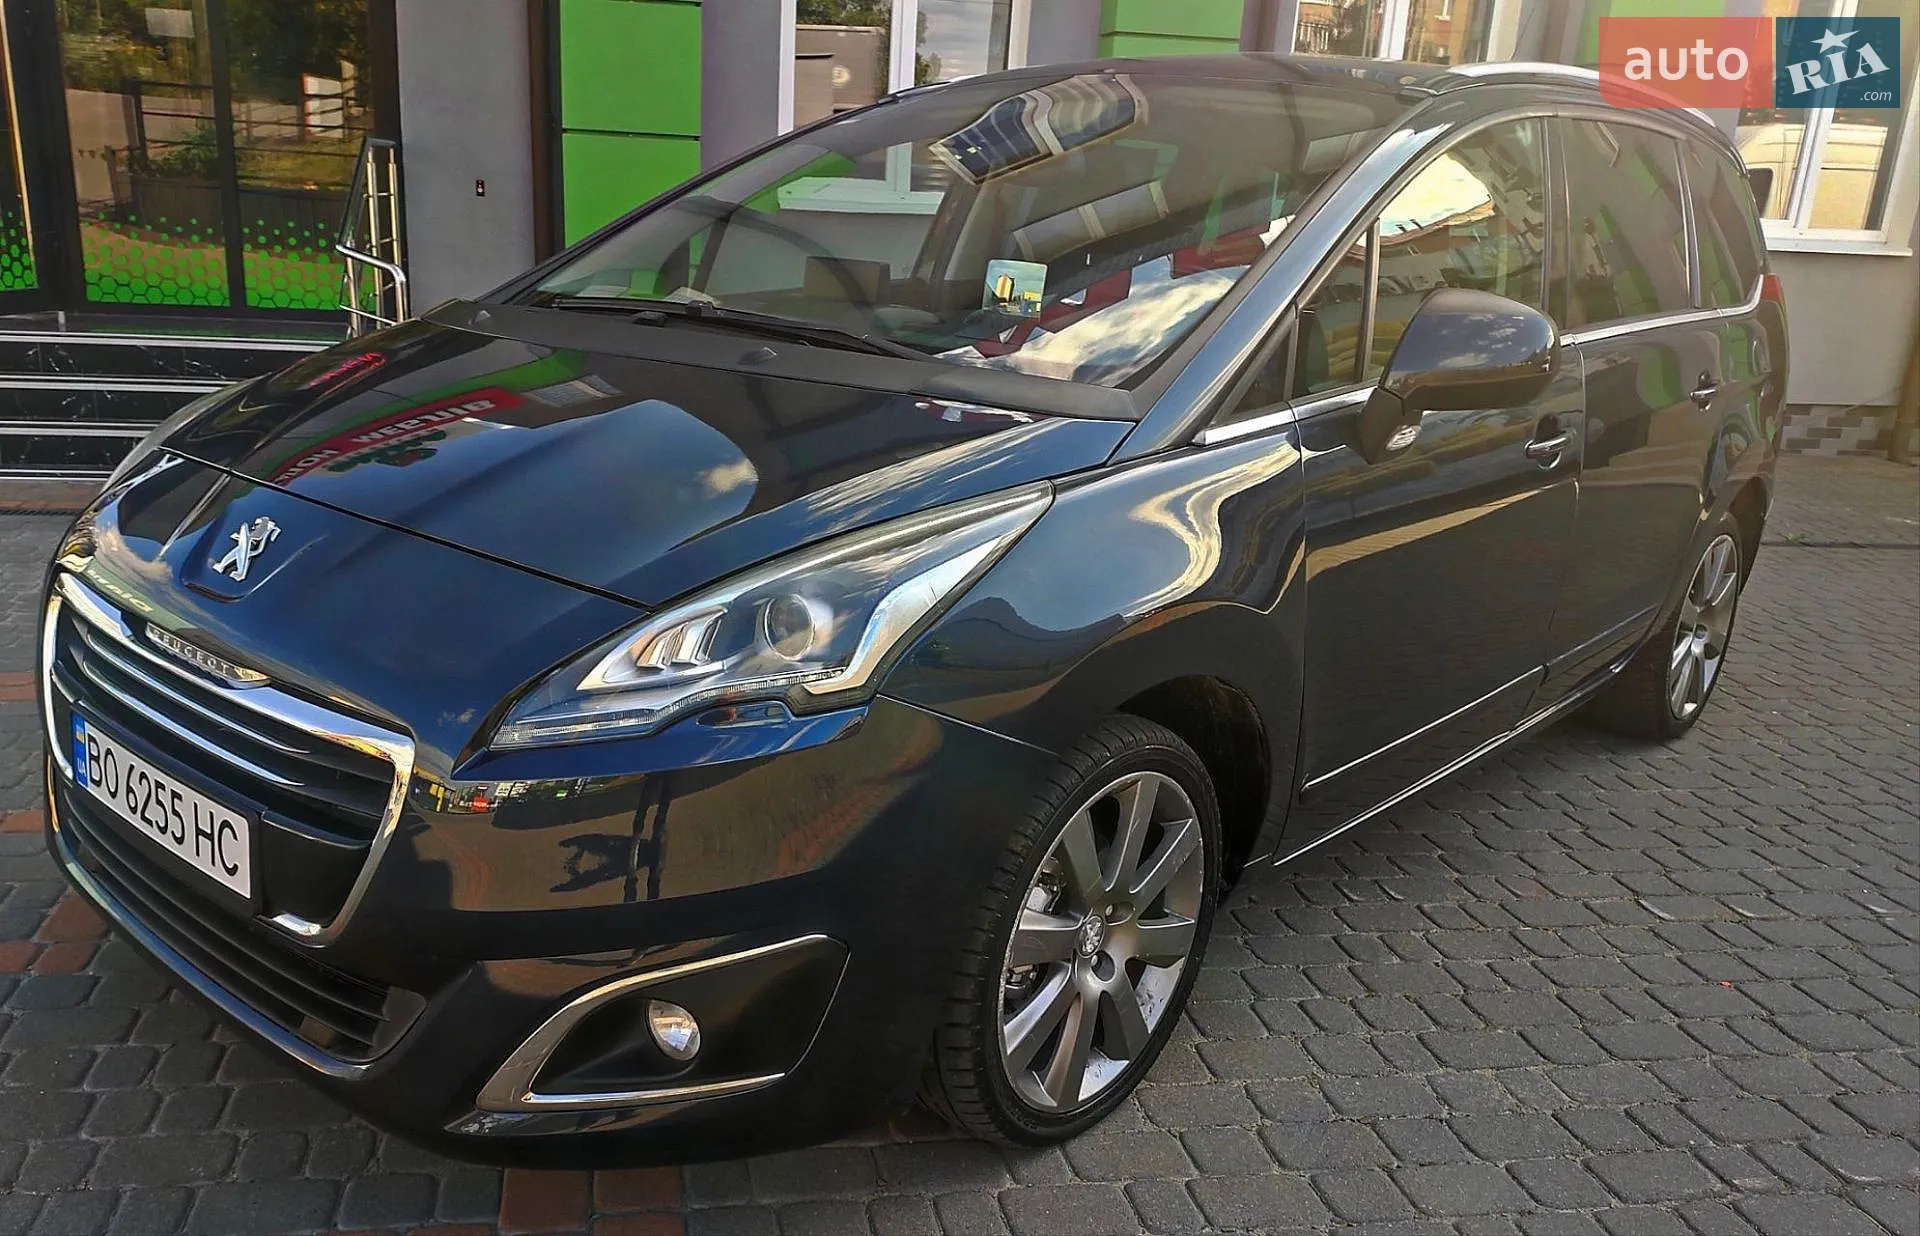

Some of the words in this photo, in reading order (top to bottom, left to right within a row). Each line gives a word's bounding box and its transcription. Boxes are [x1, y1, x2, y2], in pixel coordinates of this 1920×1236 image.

[151, 627, 232, 676] PEUGEOT
[87, 732, 120, 799] BO
[125, 763, 186, 846] 6255
[192, 800, 239, 877] HC
